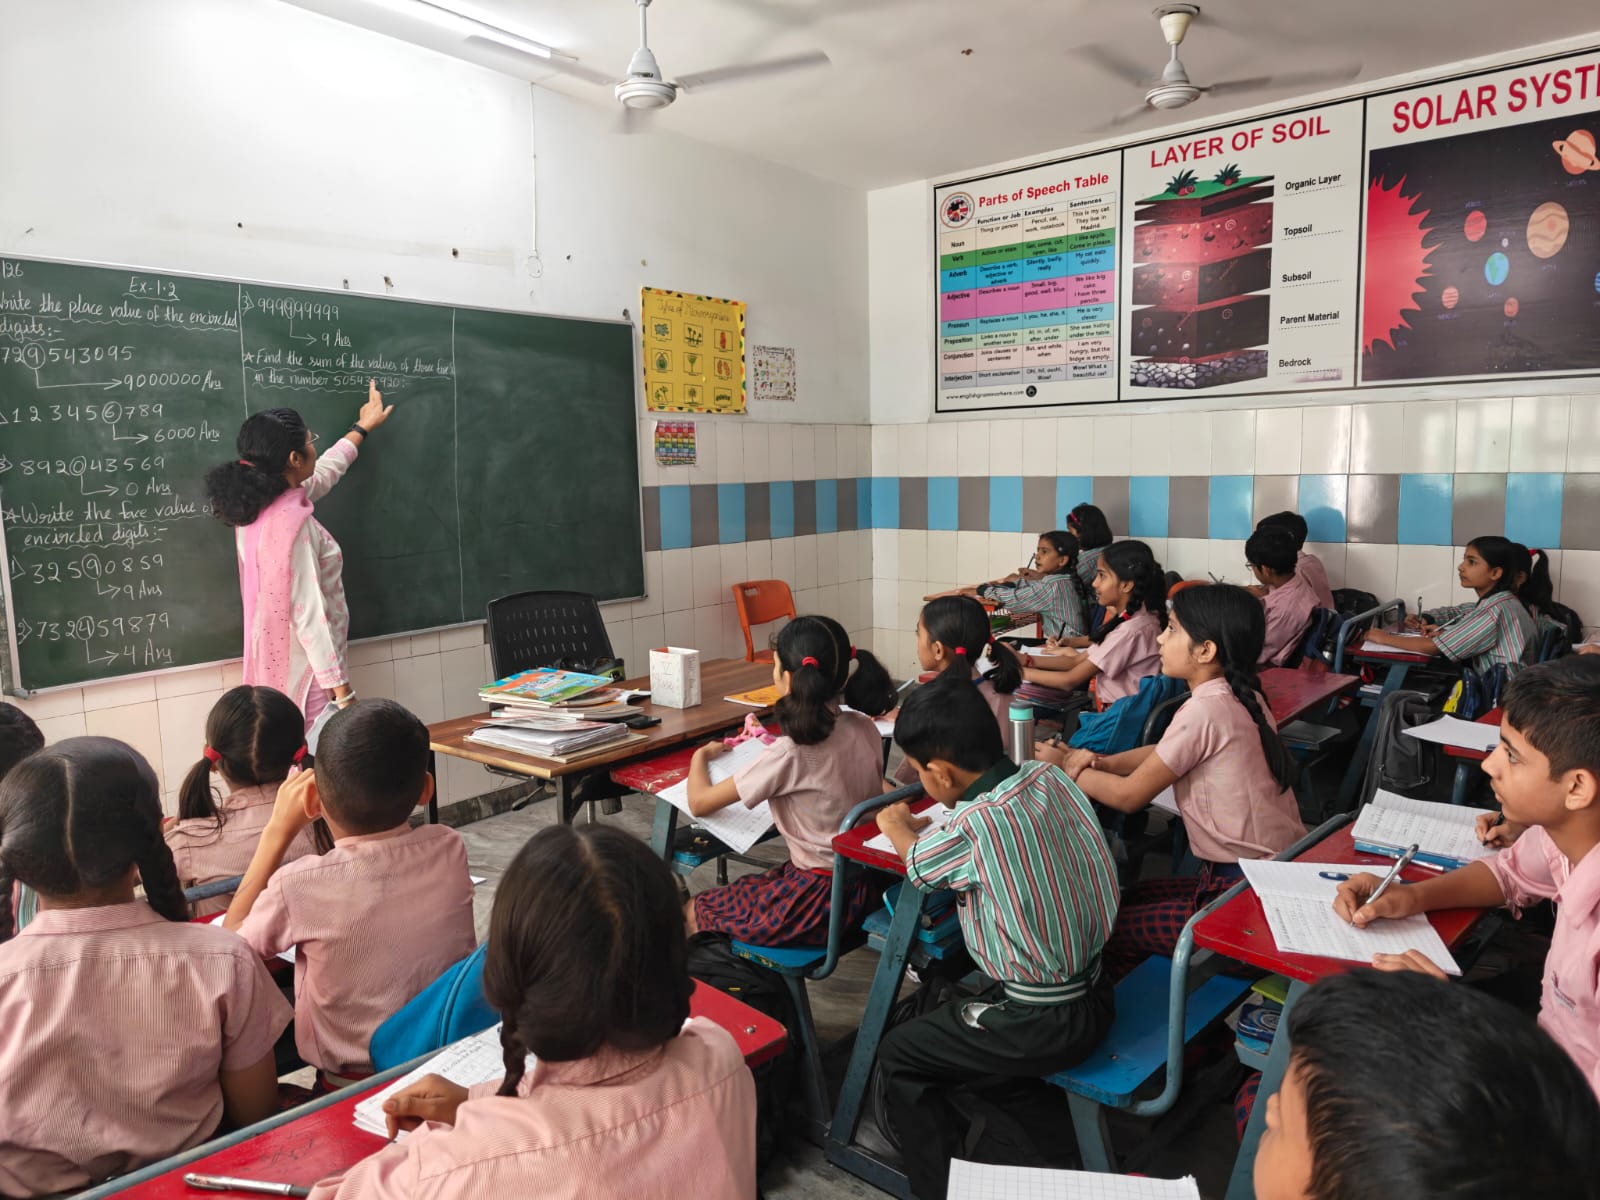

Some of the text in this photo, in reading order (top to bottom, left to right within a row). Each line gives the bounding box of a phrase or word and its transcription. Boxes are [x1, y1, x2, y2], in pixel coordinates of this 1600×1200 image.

[1392, 62, 1600, 134] SOLAR SYST
[1150, 115, 1331, 169] LAYER OF SOIL
[978, 172, 1109, 208] Parts of Speech Table
[1285, 174, 1342, 191] Organic Layer
[1025, 207, 1054, 216] Examples
[1070, 198, 1102, 208] Sentences
[978, 216, 1000, 224] Function
[1284, 224, 1313, 236] Topsoil
[3, 260, 24, 278] 126
[1282, 271, 1312, 282] Subsoil
[39, 293, 62, 313] the
[68, 293, 103, 318] place
[110, 300, 142, 320] value
[147, 304, 159, 321] of
[165, 306, 184, 323] the
[189, 310, 238, 328] encircled
[1280, 310, 1340, 325] Parent Material
[321, 328, 352, 348] 9 Ans
[944, 337, 973, 345] Preposition
[256, 347, 282, 365] Find
[287, 350, 304, 366] the
[308, 356, 333, 368] sum
[335, 353, 348, 368] of
[350, 353, 365, 369] the
[368, 352, 397, 371] values
[401, 357, 409, 373] of
[944, 352, 974, 360] Conjunction
[1279, 357, 1312, 367] Bedrock
[124, 369, 224, 392] 9000000 Ans
[269, 368, 285, 384] the
[289, 371, 329, 386] number
[154, 420, 220, 443] 6000 Ans
[126, 477, 172, 496] 0 Ans
[21, 501, 74, 524] Write
[84, 501, 112, 520] the
[120, 500, 148, 519] face
[154, 495, 196, 517] value
[24, 523, 104, 546] encircled
[123, 579, 163, 601] 9 Ans
[123, 638, 174, 667] 4 Ans
